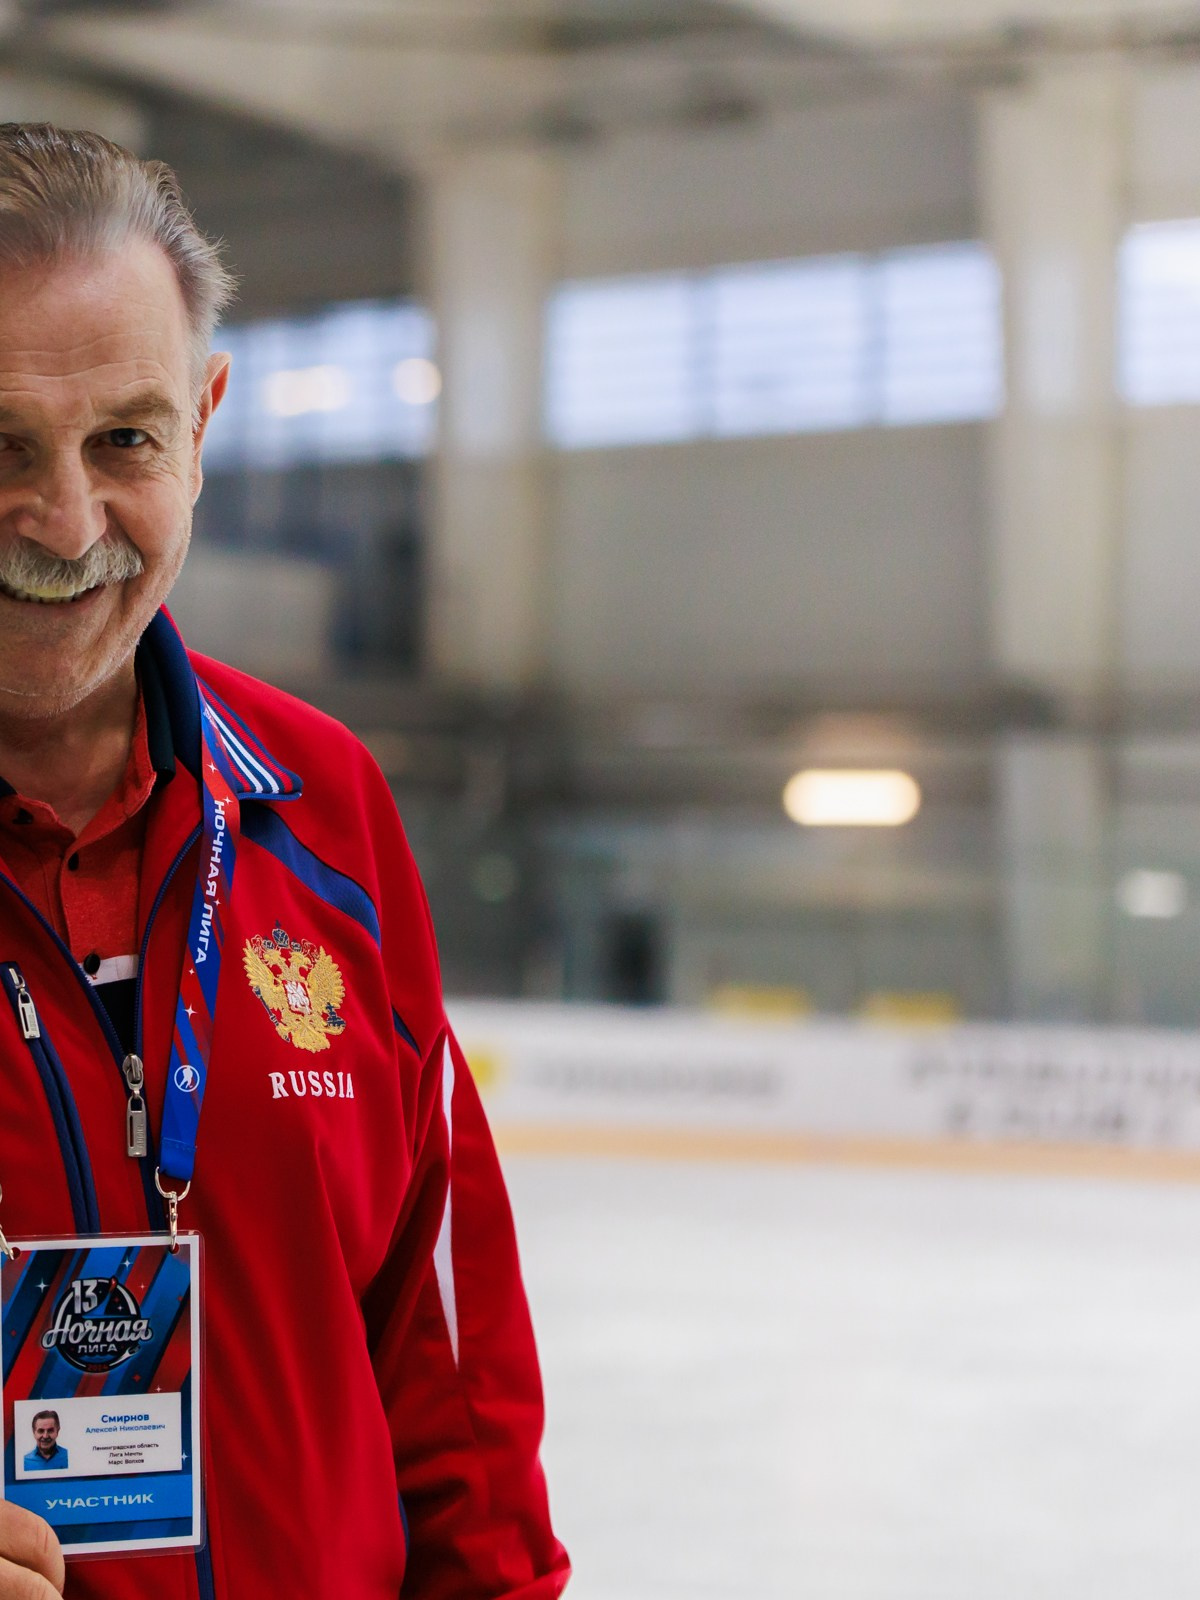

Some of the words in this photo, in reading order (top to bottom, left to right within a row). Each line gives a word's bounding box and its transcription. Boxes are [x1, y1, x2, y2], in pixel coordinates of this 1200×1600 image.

[205, 800, 226, 897] НОЧНАЯ
[195, 902, 214, 964] ЛИГА
[267, 1070, 355, 1099] RUSSIA
[71, 1279, 99, 1314] 13
[41, 1312, 153, 1349] Ночная
[77, 1343, 118, 1354] ЛИГА
[85, 1425, 118, 1434] Алексей
[119, 1423, 166, 1432] Николаевич
[100, 1413, 150, 1424] Смирнов
[45, 1493, 155, 1510] УЧАСТНИК
